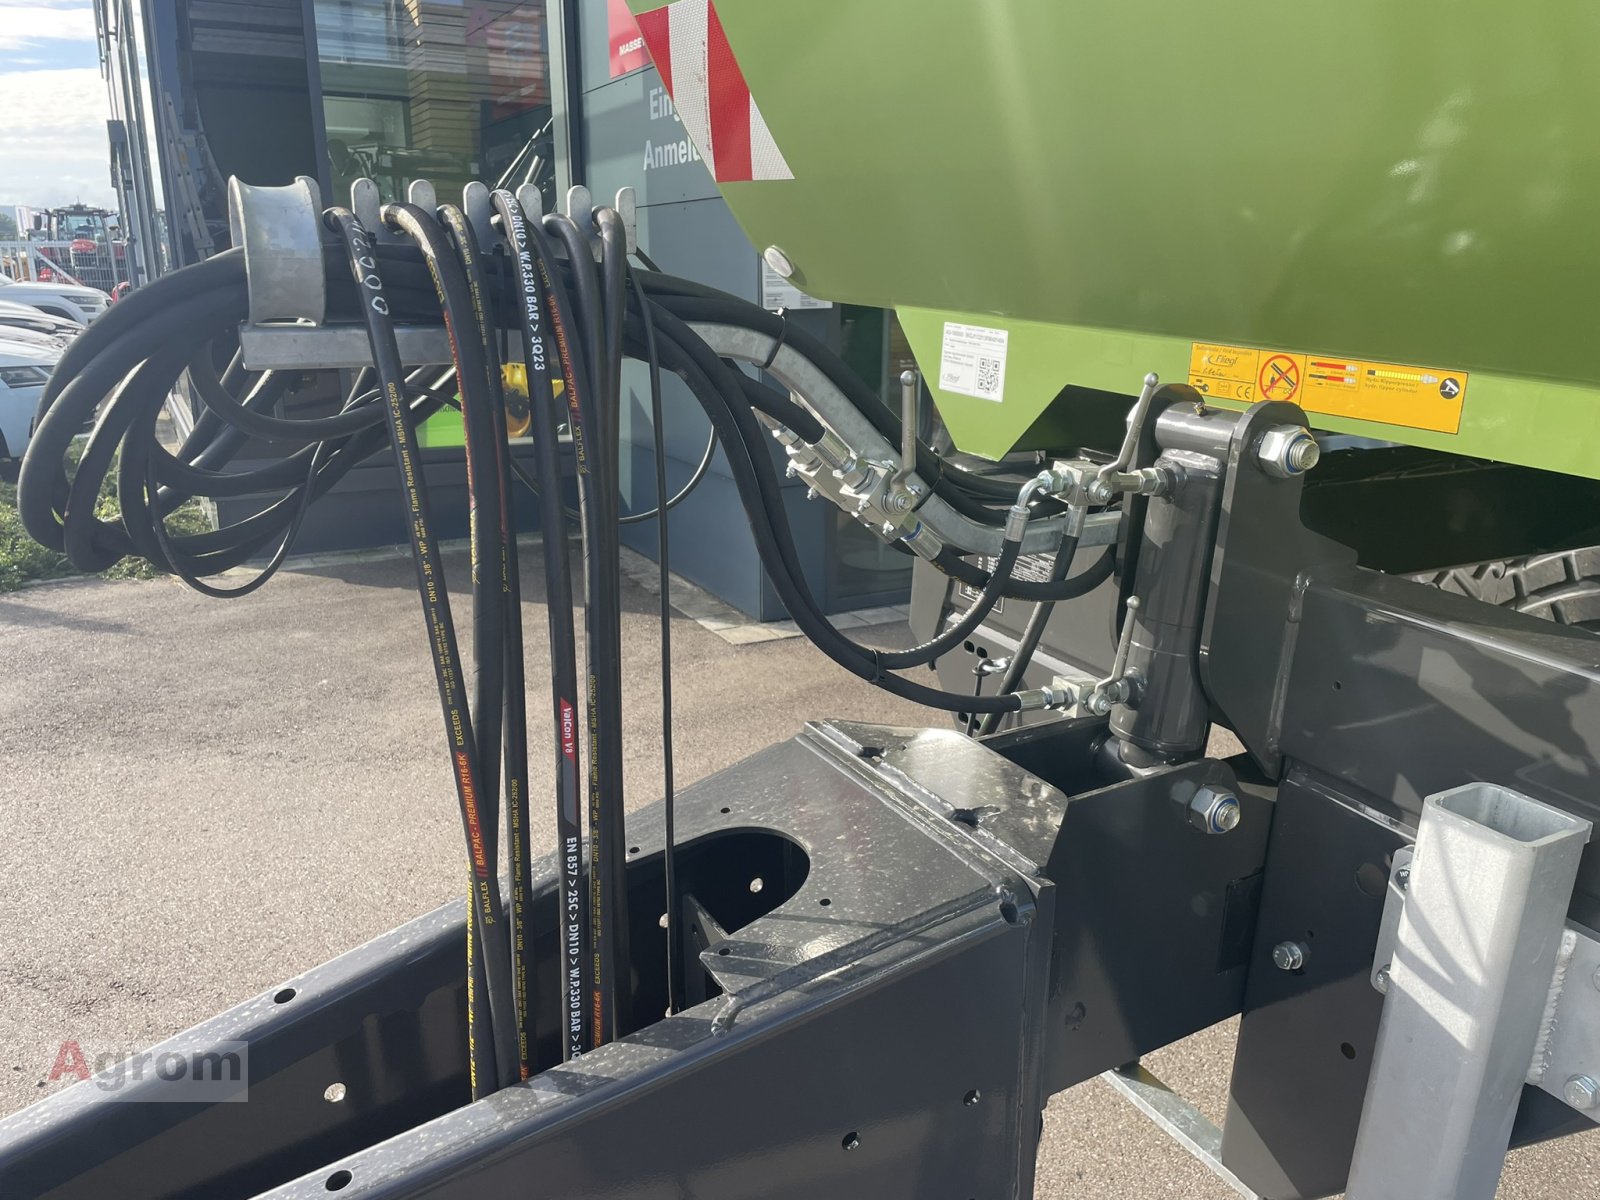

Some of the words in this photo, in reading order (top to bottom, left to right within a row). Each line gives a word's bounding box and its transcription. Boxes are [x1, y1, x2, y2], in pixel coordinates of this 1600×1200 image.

[511, 215, 527, 239] DN10
[519, 251, 534, 293] W.P.330
[526, 296, 539, 321] BAR
[531, 336, 546, 371] 3Q23
[556, 325, 569, 365] PREMIUM
[387, 382, 401, 418] IC-252/00
[566, 372, 578, 408] BALPAC
[397, 419, 407, 443] MSHA
[574, 425, 586, 461] BALFLEX
[401, 450, 414, 486] Resistant
[410, 488, 420, 512] Flame
[419, 541, 427, 554] WP
[427, 581, 437, 603] DN10
[451, 709, 464, 746] EXCEEDS
[563, 707, 573, 739] ValCon
[564, 742, 574, 753] V8
[459, 753, 471, 784] R16-6K
[463, 785, 477, 825] PREMIUM
[472, 832, 485, 866] BALPAC
[513, 833, 521, 862] Resistant
[566, 837, 577, 852] EN
[567, 855, 578, 875] 857
[480, 881, 492, 914] BALFLEX
[516, 903, 523, 914] WP
[568, 890, 579, 911] 2SC
[516, 935, 524, 951] DN10
[569, 924, 579, 955] DN10
[593, 953, 601, 985] EXCEEDS
[569, 967, 580, 1008] W.P.330
[570, 1010, 581, 1032] BAR
[593, 1018, 602, 1047] EMIUM
[520, 1032, 528, 1060] EXCEEDS
